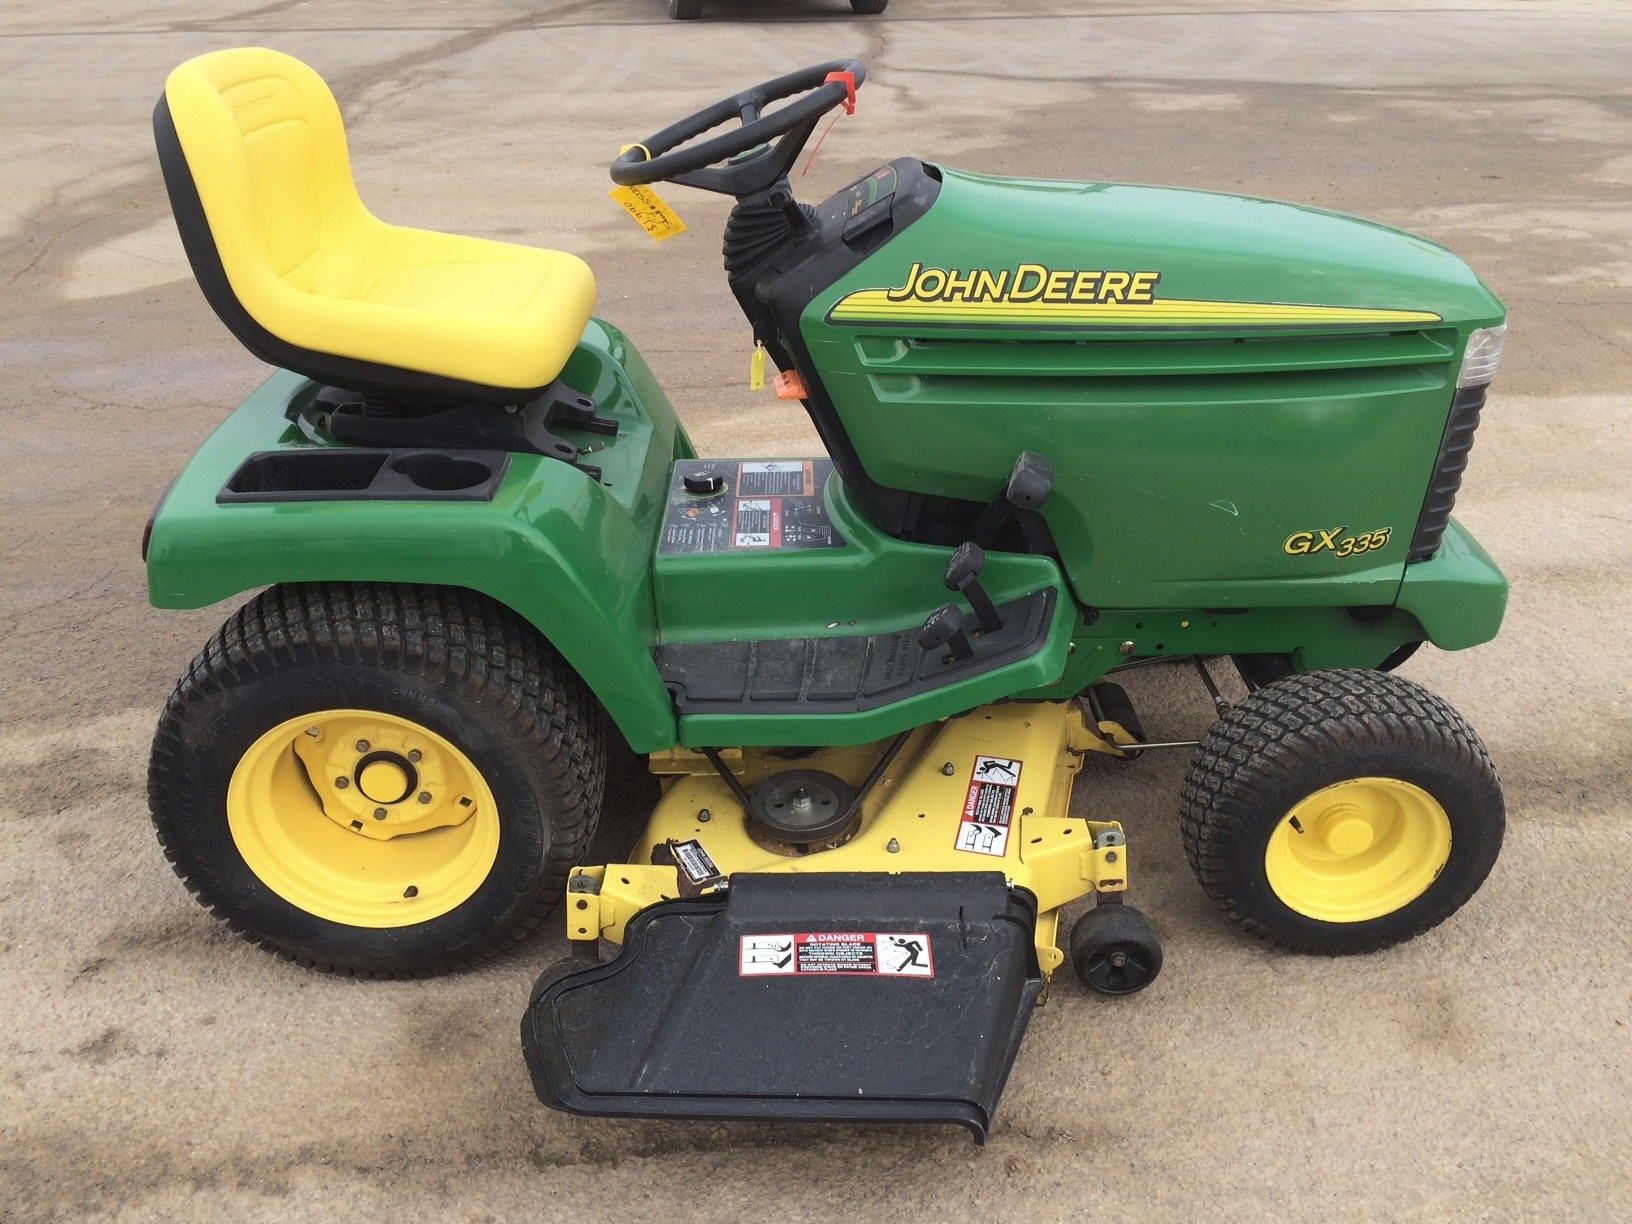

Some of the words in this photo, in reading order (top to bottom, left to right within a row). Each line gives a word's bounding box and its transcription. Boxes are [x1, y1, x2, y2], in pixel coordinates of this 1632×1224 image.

[887, 262, 1011, 303] JOHN
[1008, 262, 1162, 304] DEERE
[1283, 525, 1392, 559] GX335
[966, 785, 979, 811] DANGER
[818, 934, 865, 942] DANGER
